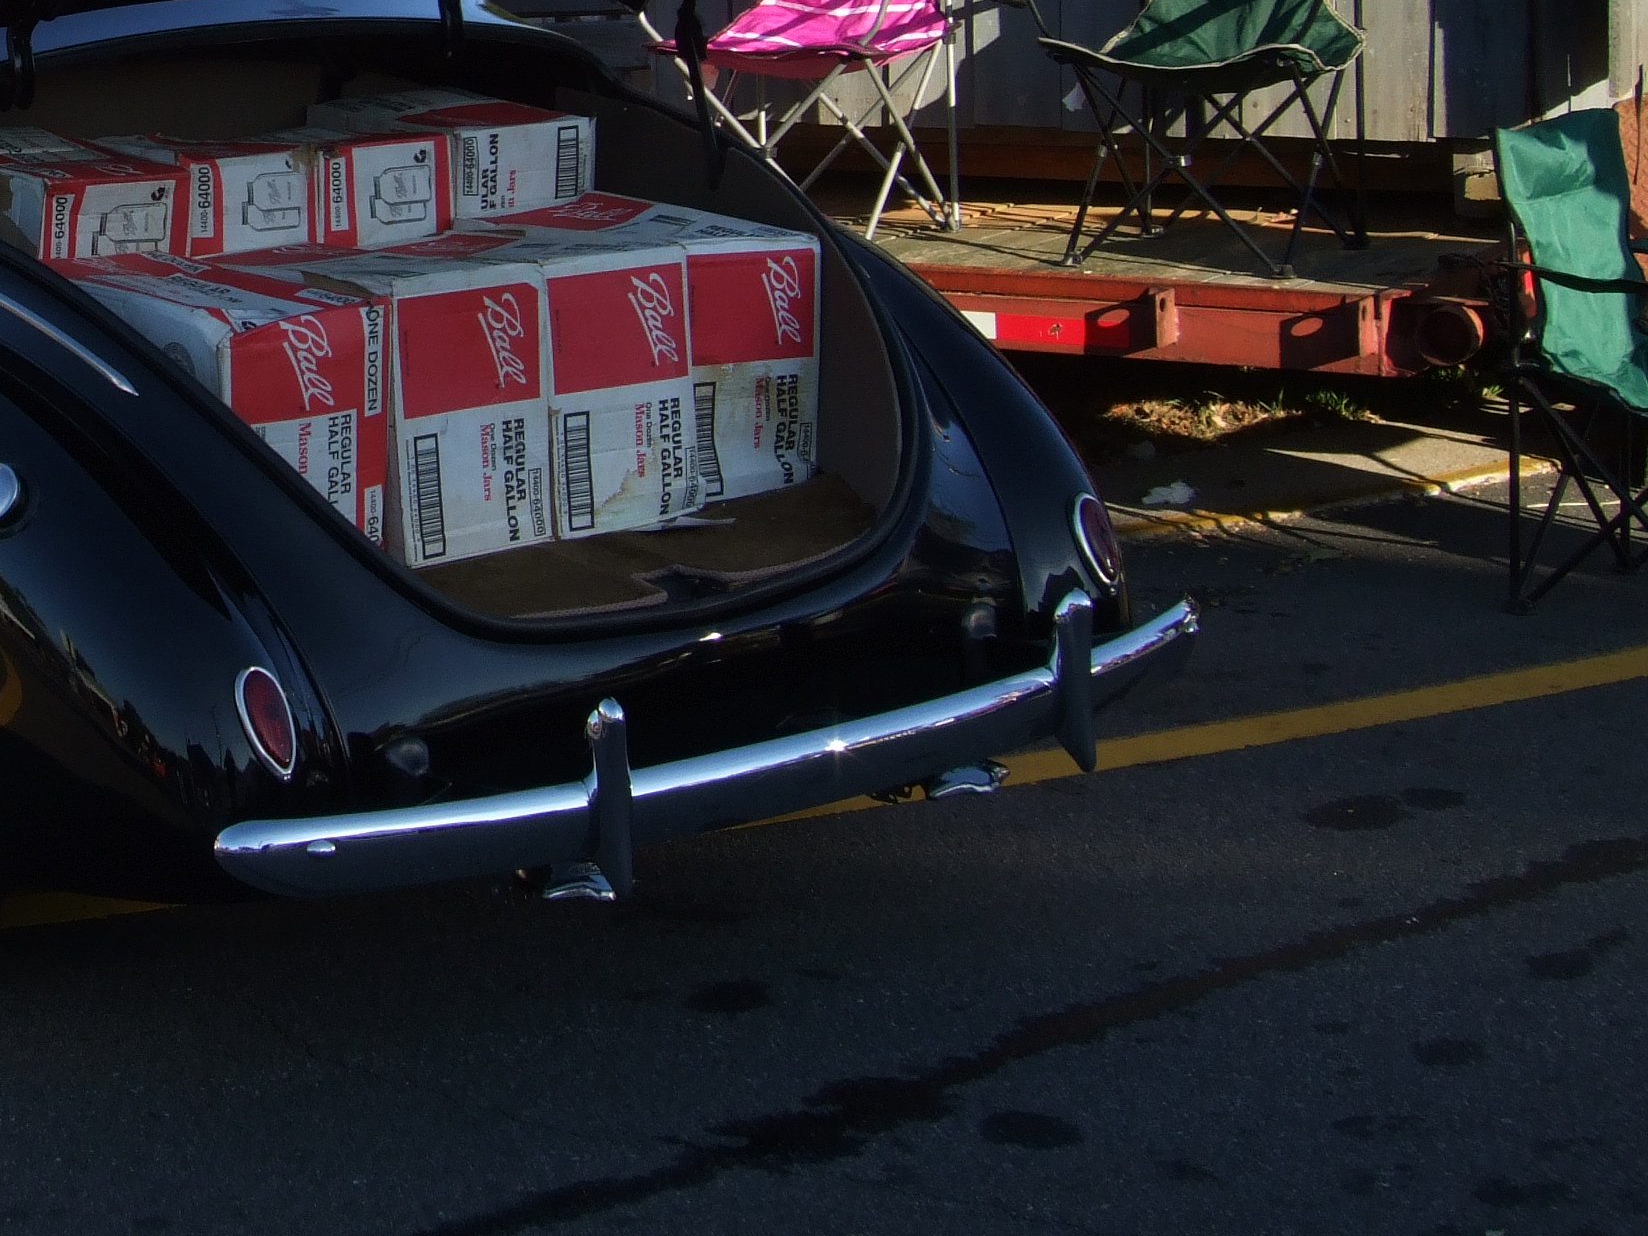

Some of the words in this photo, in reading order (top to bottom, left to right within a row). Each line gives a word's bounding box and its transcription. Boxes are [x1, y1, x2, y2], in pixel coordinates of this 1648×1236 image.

[331, 161, 343, 228] 14400-64000
[481, 168, 490, 210] ULAR
[489, 133, 499, 195] GALLON
[507, 170, 516, 195] Jars
[55, 196, 68, 259] 400-64000
[197, 166, 212, 233] 14400-64000
[365, 308, 380, 346] ONE
[627, 272, 680, 367] Ball
[761, 255, 801, 345] Ball
[278, 314, 334, 411] Ball
[478, 292, 526, 389] Ball
[366, 351, 379, 412] DOZEN
[755, 377, 764, 419] Mason
[776, 375, 788, 417] HALF
[328, 416, 340, 460] HALF
[502, 420, 514, 466] HALF
[635, 403, 646, 446] Mason
[659, 399, 671, 443] HALF
[670, 397, 683, 478] REGULAR
[754, 422, 763, 450] Jars
[785, 374, 798, 451] REGULAR
[298, 422, 312, 475] Mason
[340, 413, 352, 495] REGULAR
[480, 425, 491, 469] Mason
[514, 418, 526, 501] REGULAR
[636, 450, 647, 478] Jars
[775, 422, 794, 485] GALLON
[482, 472, 492, 501] Jars
[504, 470, 520, 542] GALLON
[531, 470, 543, 534] 14400-64000
[660, 448, 672, 515] GALLON
[367, 490, 380, 543] 14400-640
